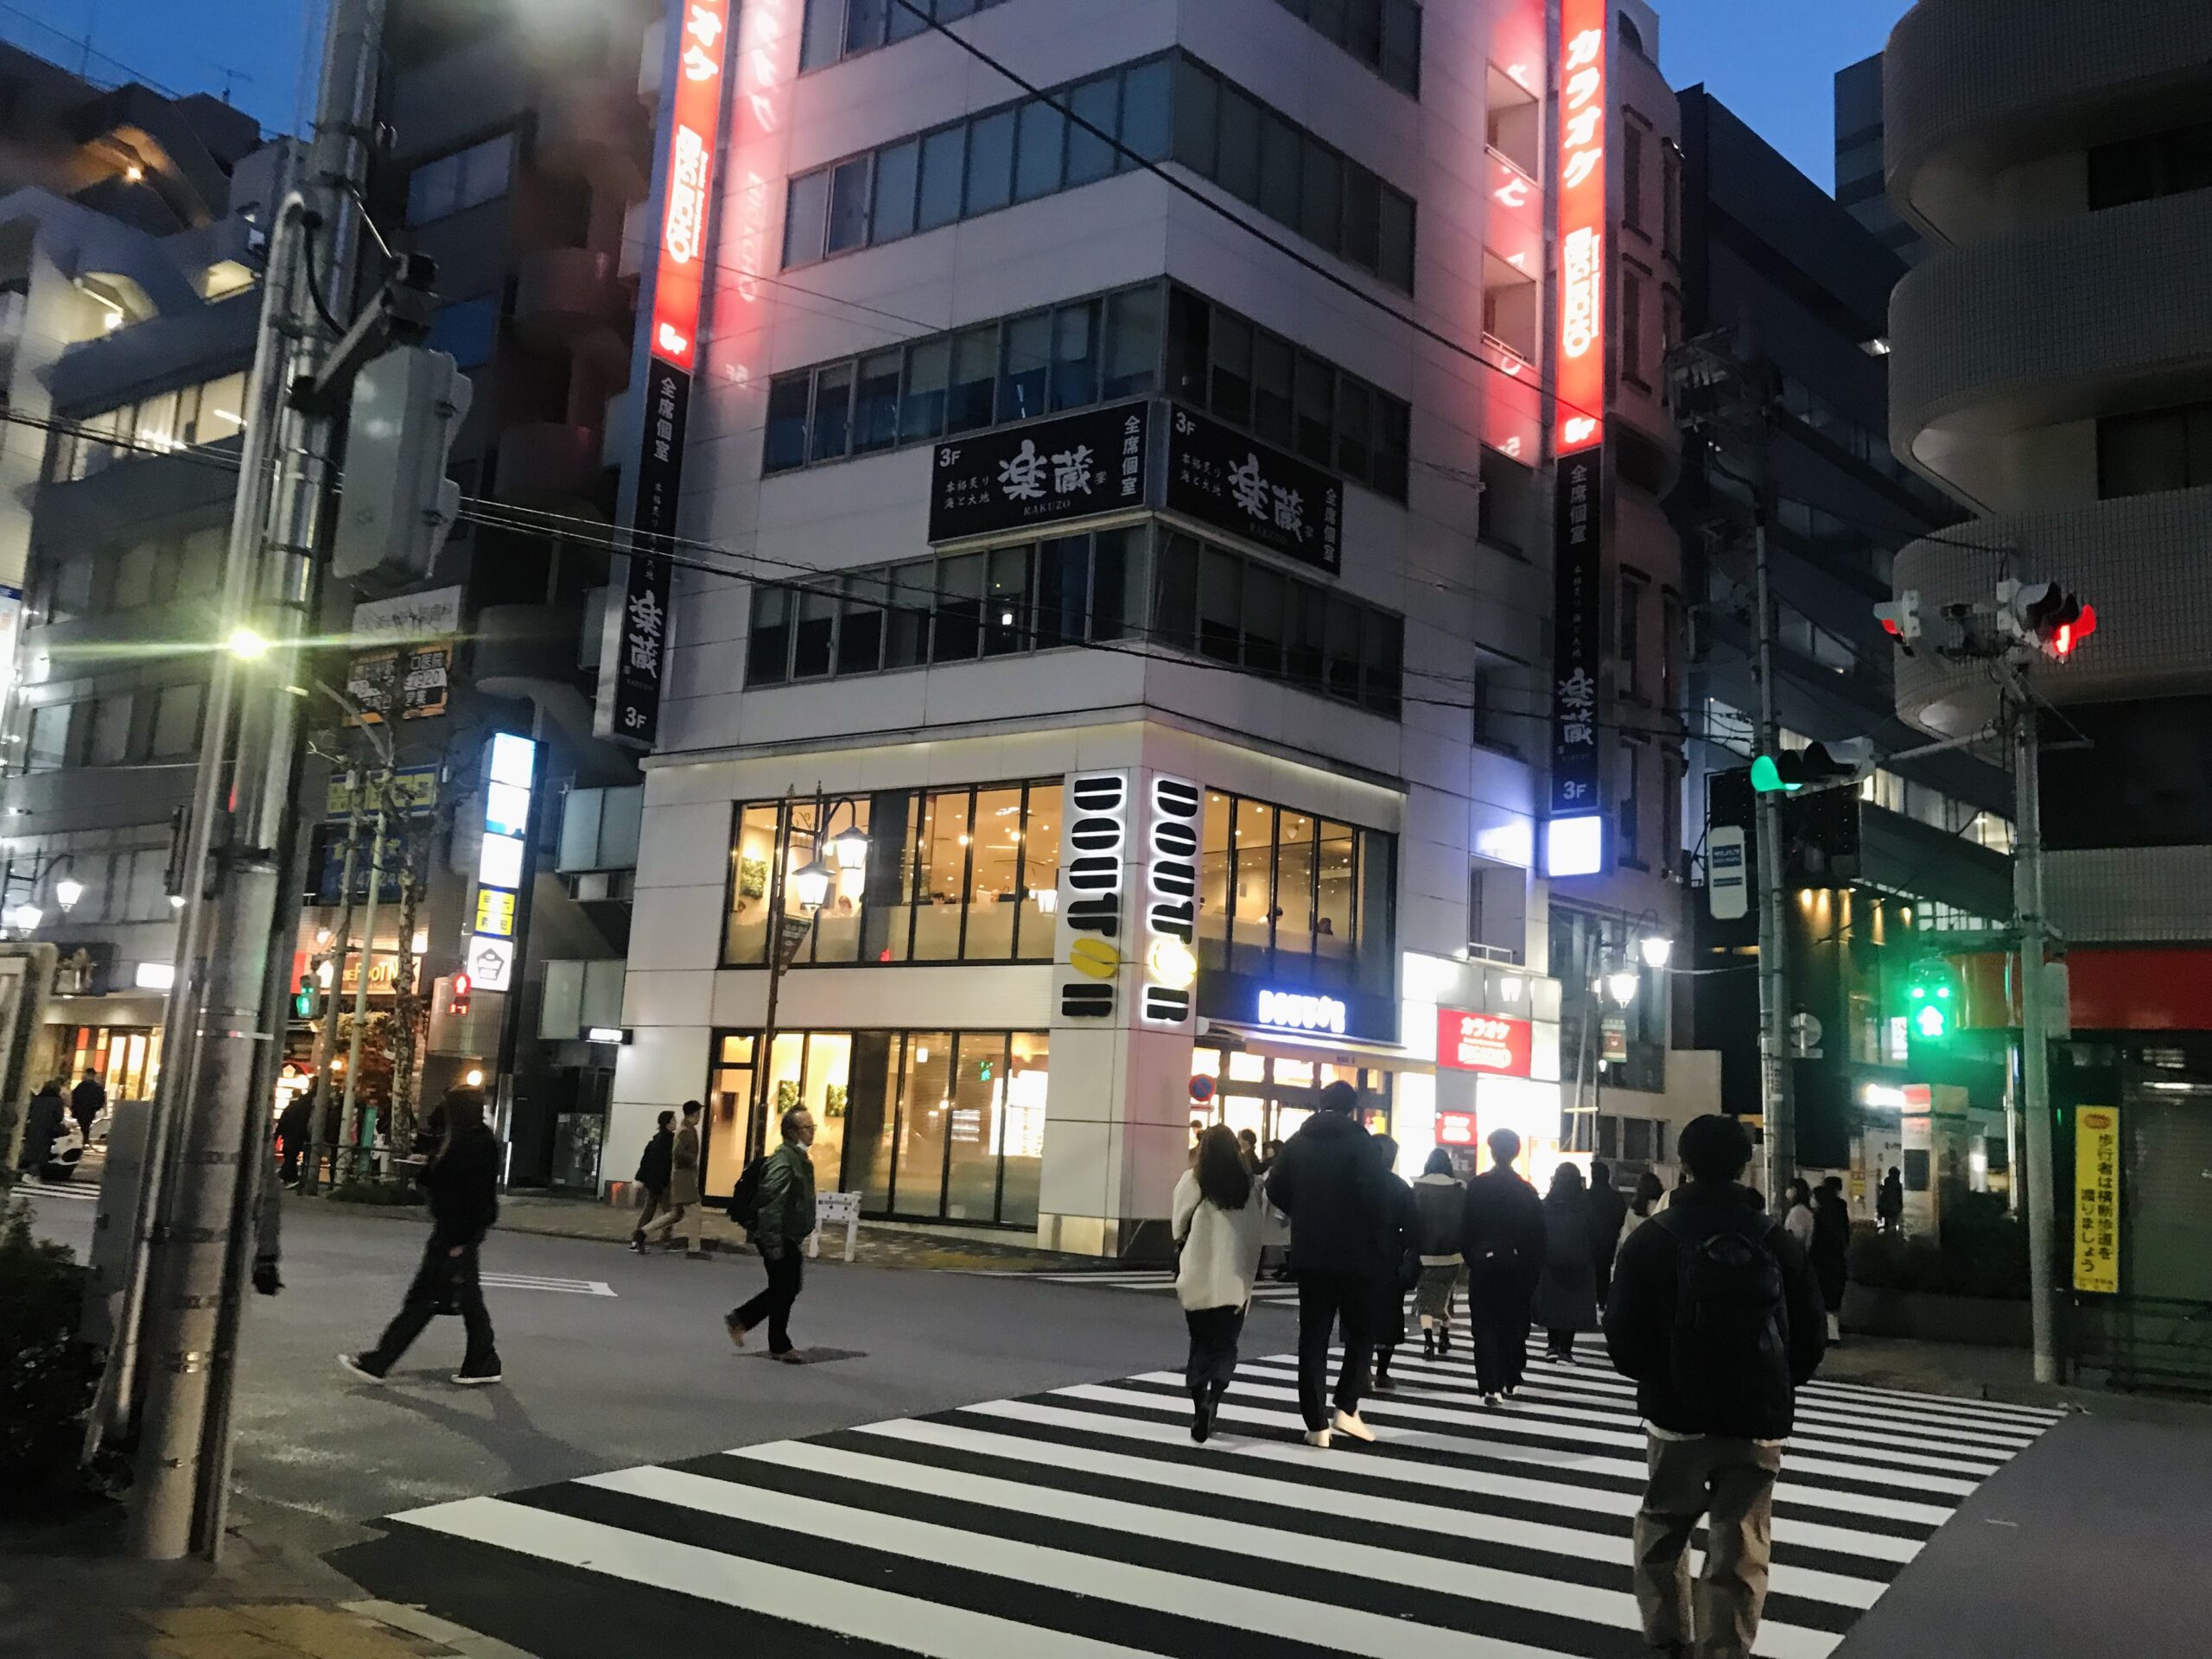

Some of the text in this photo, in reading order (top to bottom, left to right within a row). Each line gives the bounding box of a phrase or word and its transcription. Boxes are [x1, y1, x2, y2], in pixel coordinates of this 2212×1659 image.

[1563, 29, 1602, 188] カラオケ
[654, 376, 677, 463] 全席個室
[939, 448, 962, 467] 3F
[1121, 415, 1141, 497] 全席個室
[1176, 411, 1196, 435] 3F
[997, 439, 1094, 501] 楽蔵
[1023, 499, 1072, 517] RAKUZO
[1227, 452, 1304, 543] 楽蔵
[1569, 464, 1588, 543] 全席個室
[629, 589, 664, 679] 楽蔵
[624, 706, 647, 729] 3F
[1558, 668, 1594, 746] 楽蔵
[1563, 779, 1587, 800] 3F
[1061, 776, 1123, 1018] DOUTOR
[1146, 779, 1198, 1023] DOUTOR
[1460, 1017, 1510, 1039] カラオケ
